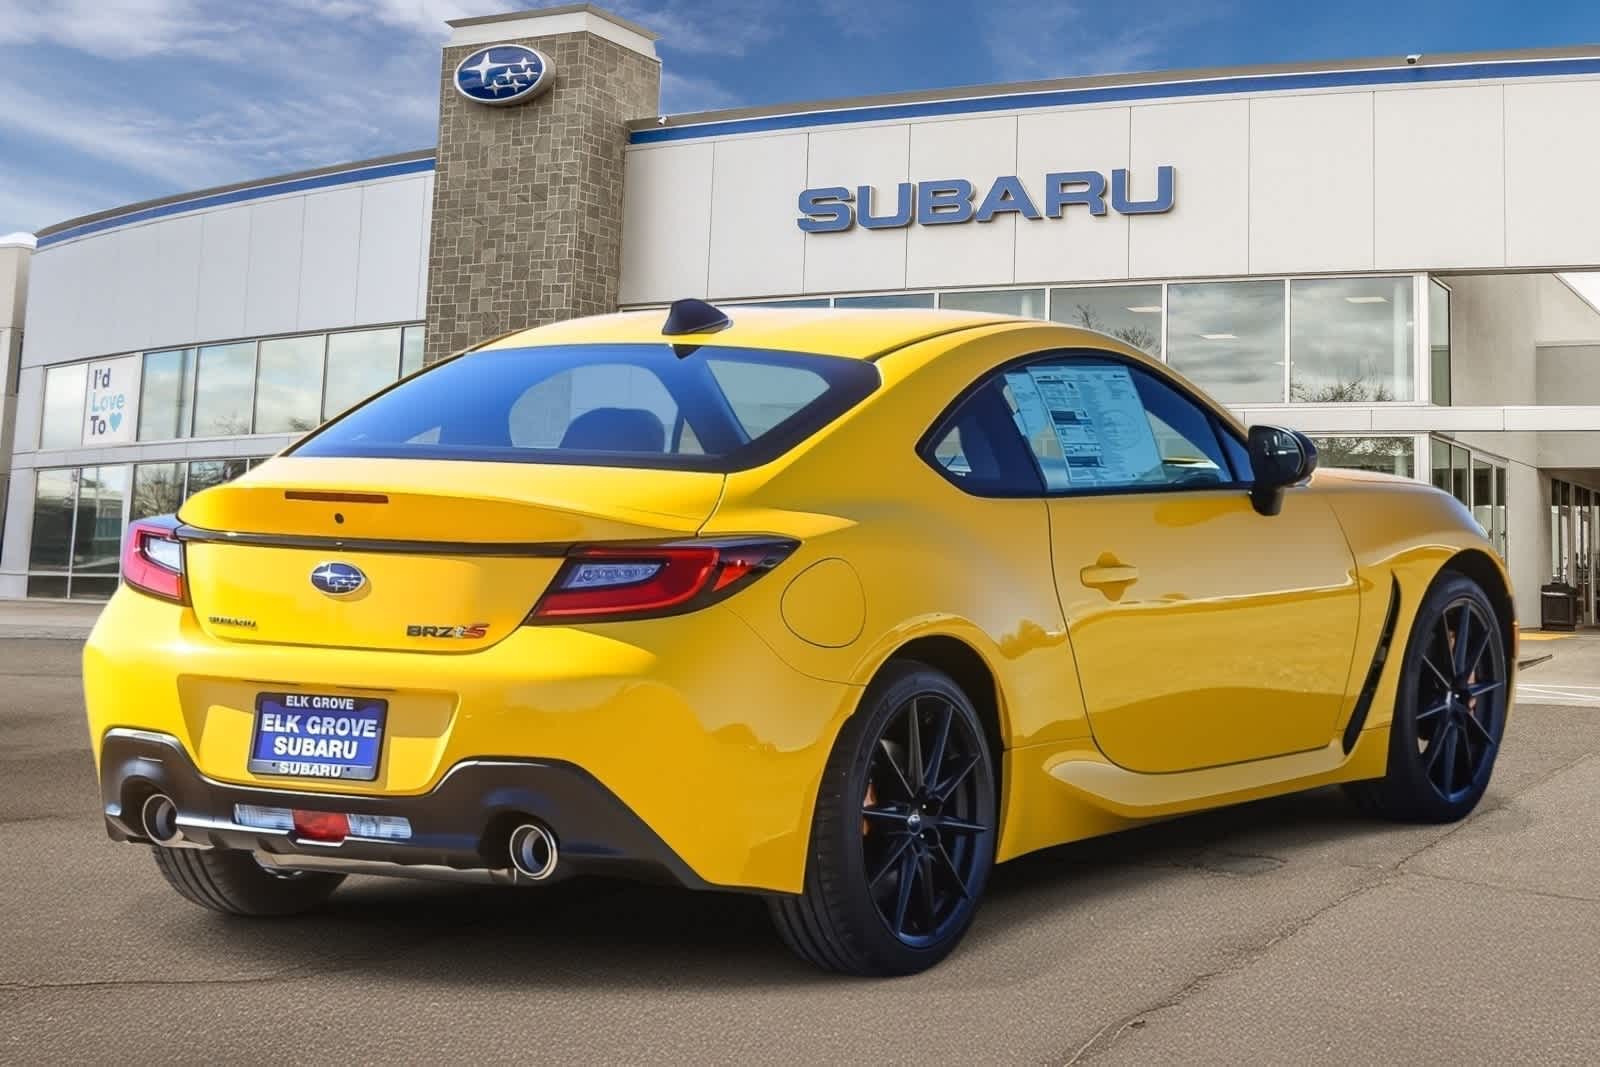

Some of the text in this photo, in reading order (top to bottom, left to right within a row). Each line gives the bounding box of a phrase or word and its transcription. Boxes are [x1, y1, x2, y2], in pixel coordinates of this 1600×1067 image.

[796, 165, 1174, 233] SUBARU
[93, 367, 111, 390] I'd
[91, 391, 125, 412] Love
[90, 415, 106, 435] To
[286, 695, 355, 710] ELK GROVE
[261, 713, 378, 738] ELK GROVE
[273, 736, 358, 760] SUBARU
[279, 761, 342, 777] SUBARU
